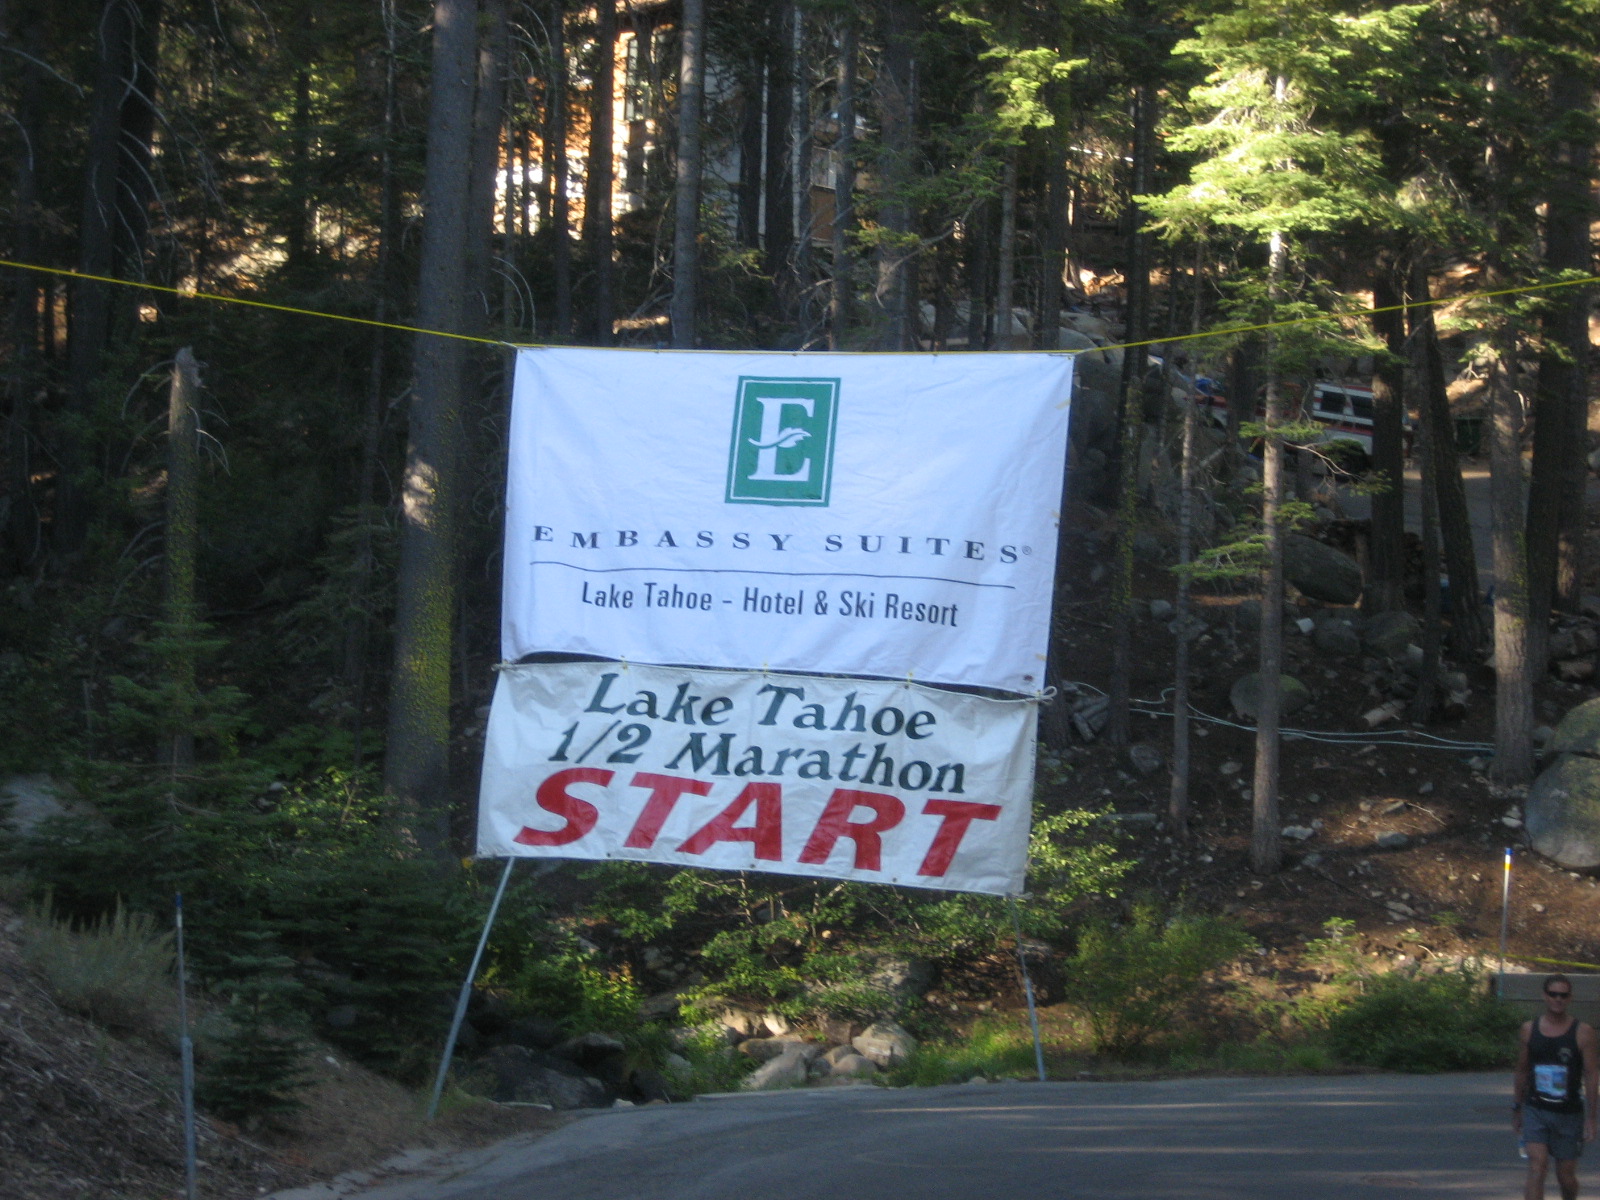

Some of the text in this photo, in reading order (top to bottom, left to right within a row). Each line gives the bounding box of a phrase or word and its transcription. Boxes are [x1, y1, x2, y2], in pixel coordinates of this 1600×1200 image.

[747, 397, 815, 481] E
[533, 526, 793, 551] EMBASSY
[582, 582, 633, 609] Lake
[644, 583, 712, 611] Tahoe
[743, 588, 804, 616] Hotel
[815, 592, 828, 616] &
[839, 592, 876, 619] Ski
[885, 595, 958, 627] Resort
[585, 673, 937, 740] Lake Tahoe
[548, 721, 966, 793] 1/2 Marathon
[513, 767, 1002, 877] START
